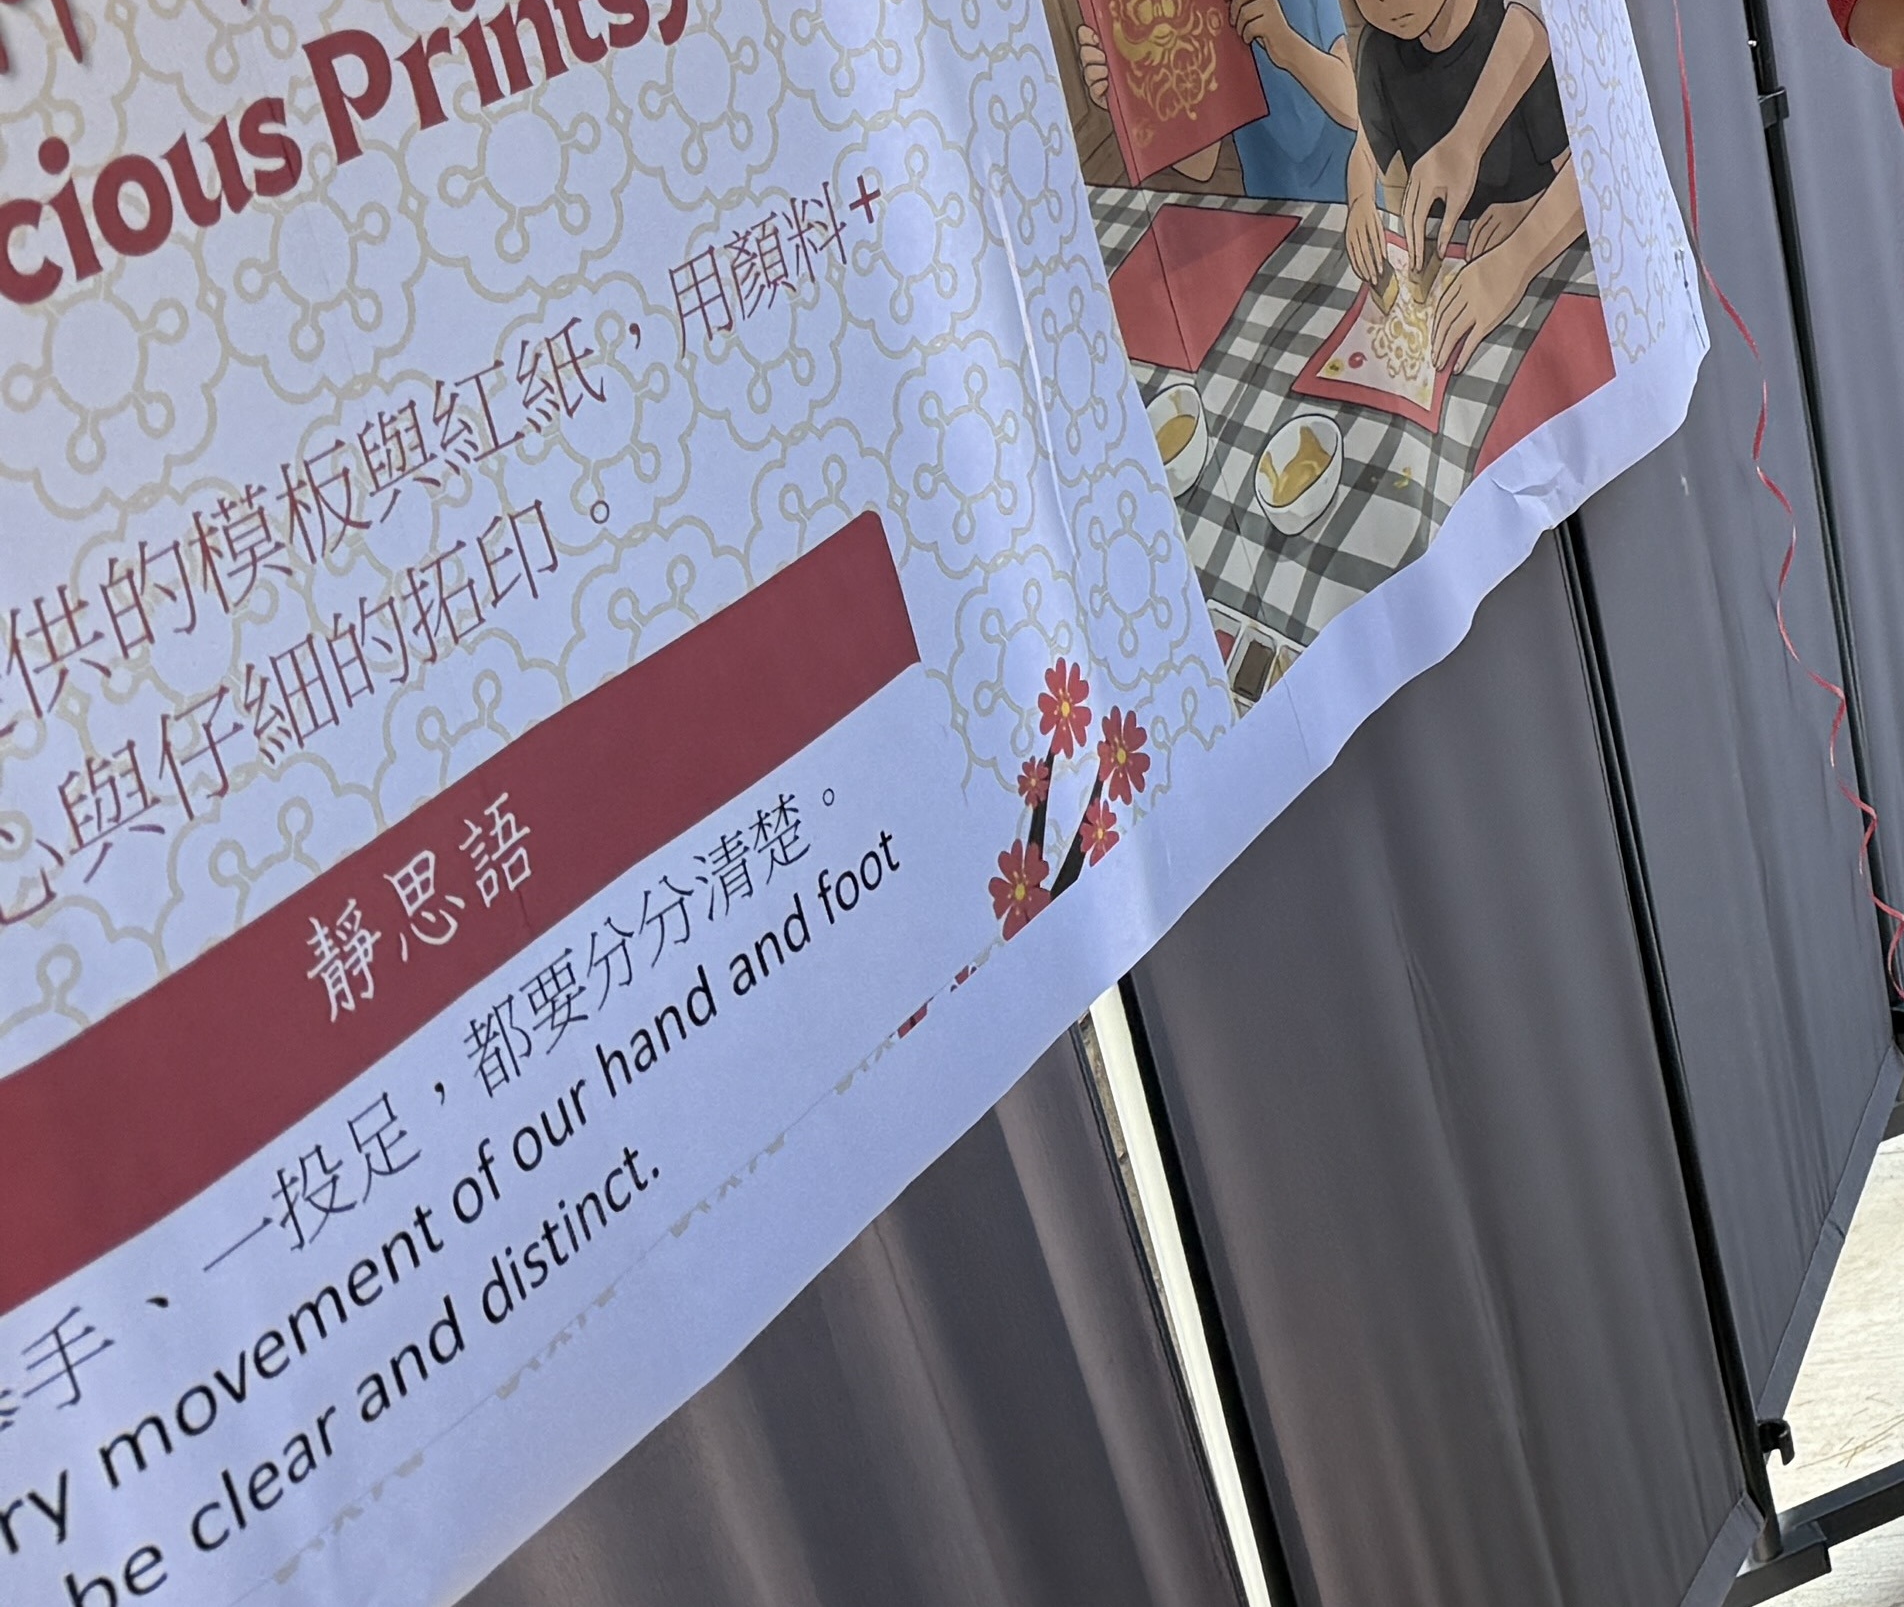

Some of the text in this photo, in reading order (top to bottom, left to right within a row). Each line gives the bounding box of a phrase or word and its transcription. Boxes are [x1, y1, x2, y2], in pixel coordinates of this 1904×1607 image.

[306, 792, 532, 1023] 靜思語
[98, 1204, 445, 1490] movement
[452, 1138, 501, 1224] of
[511, 1079, 588, 1172] our
[596, 965, 718, 1098] hand
[730, 894, 811, 995] and
[816, 831, 902, 925] foot
[189, 1405, 336, 1554] clear
[355, 1295, 467, 1423] and
[480, 1146, 661, 1325] distinct.
